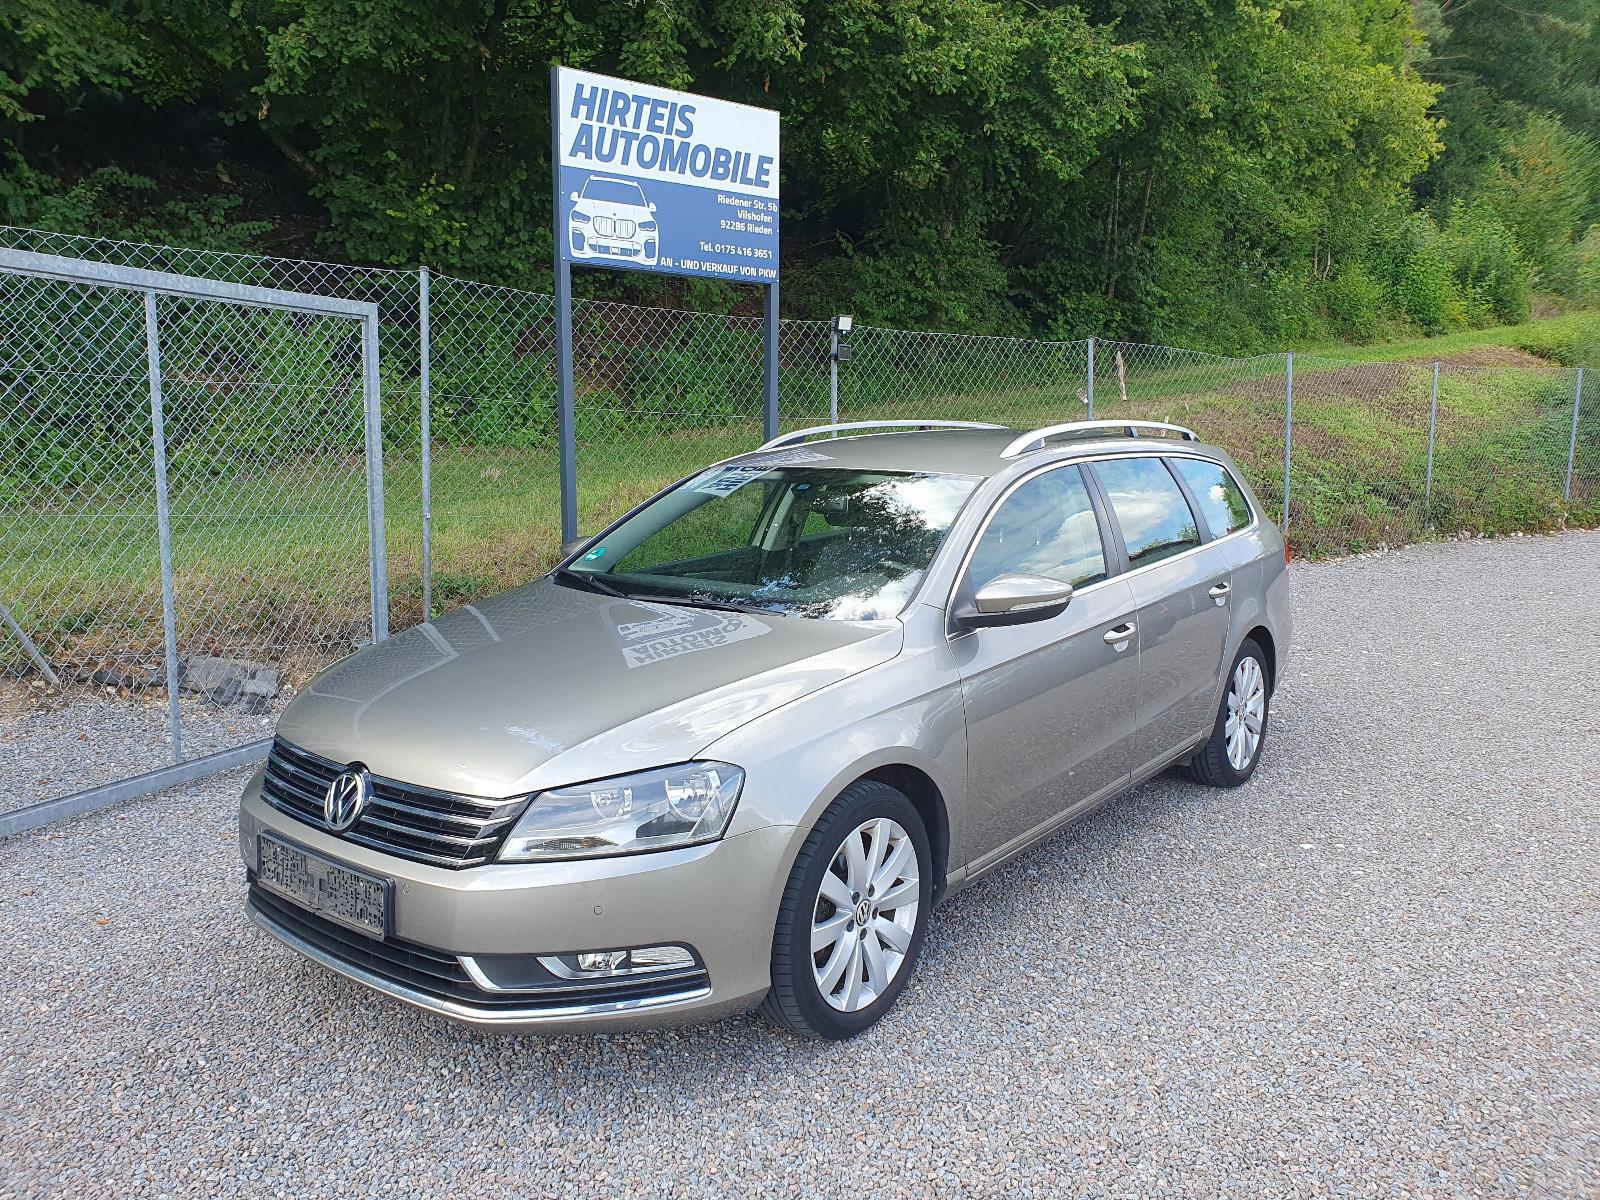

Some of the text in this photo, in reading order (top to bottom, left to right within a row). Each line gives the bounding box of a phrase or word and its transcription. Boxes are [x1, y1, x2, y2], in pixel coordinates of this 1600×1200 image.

[570, 82, 697, 139] HIRTEIS
[568, 123, 774, 189] AUTOMOBILE
[717, 194, 778, 212] Riedener Str. 5b
[737, 209, 773, 223] Vilshofen
[720, 219, 773, 235] 92286 Rieden
[699, 241, 772, 259] Tel. 0175 416 3651
[660, 257, 673, 267] AN
[680, 259, 700, 270] UND
[700, 262, 738, 276] VERKAUF
[740, 265, 757, 277] VON
[758, 269, 777, 279] PKW
